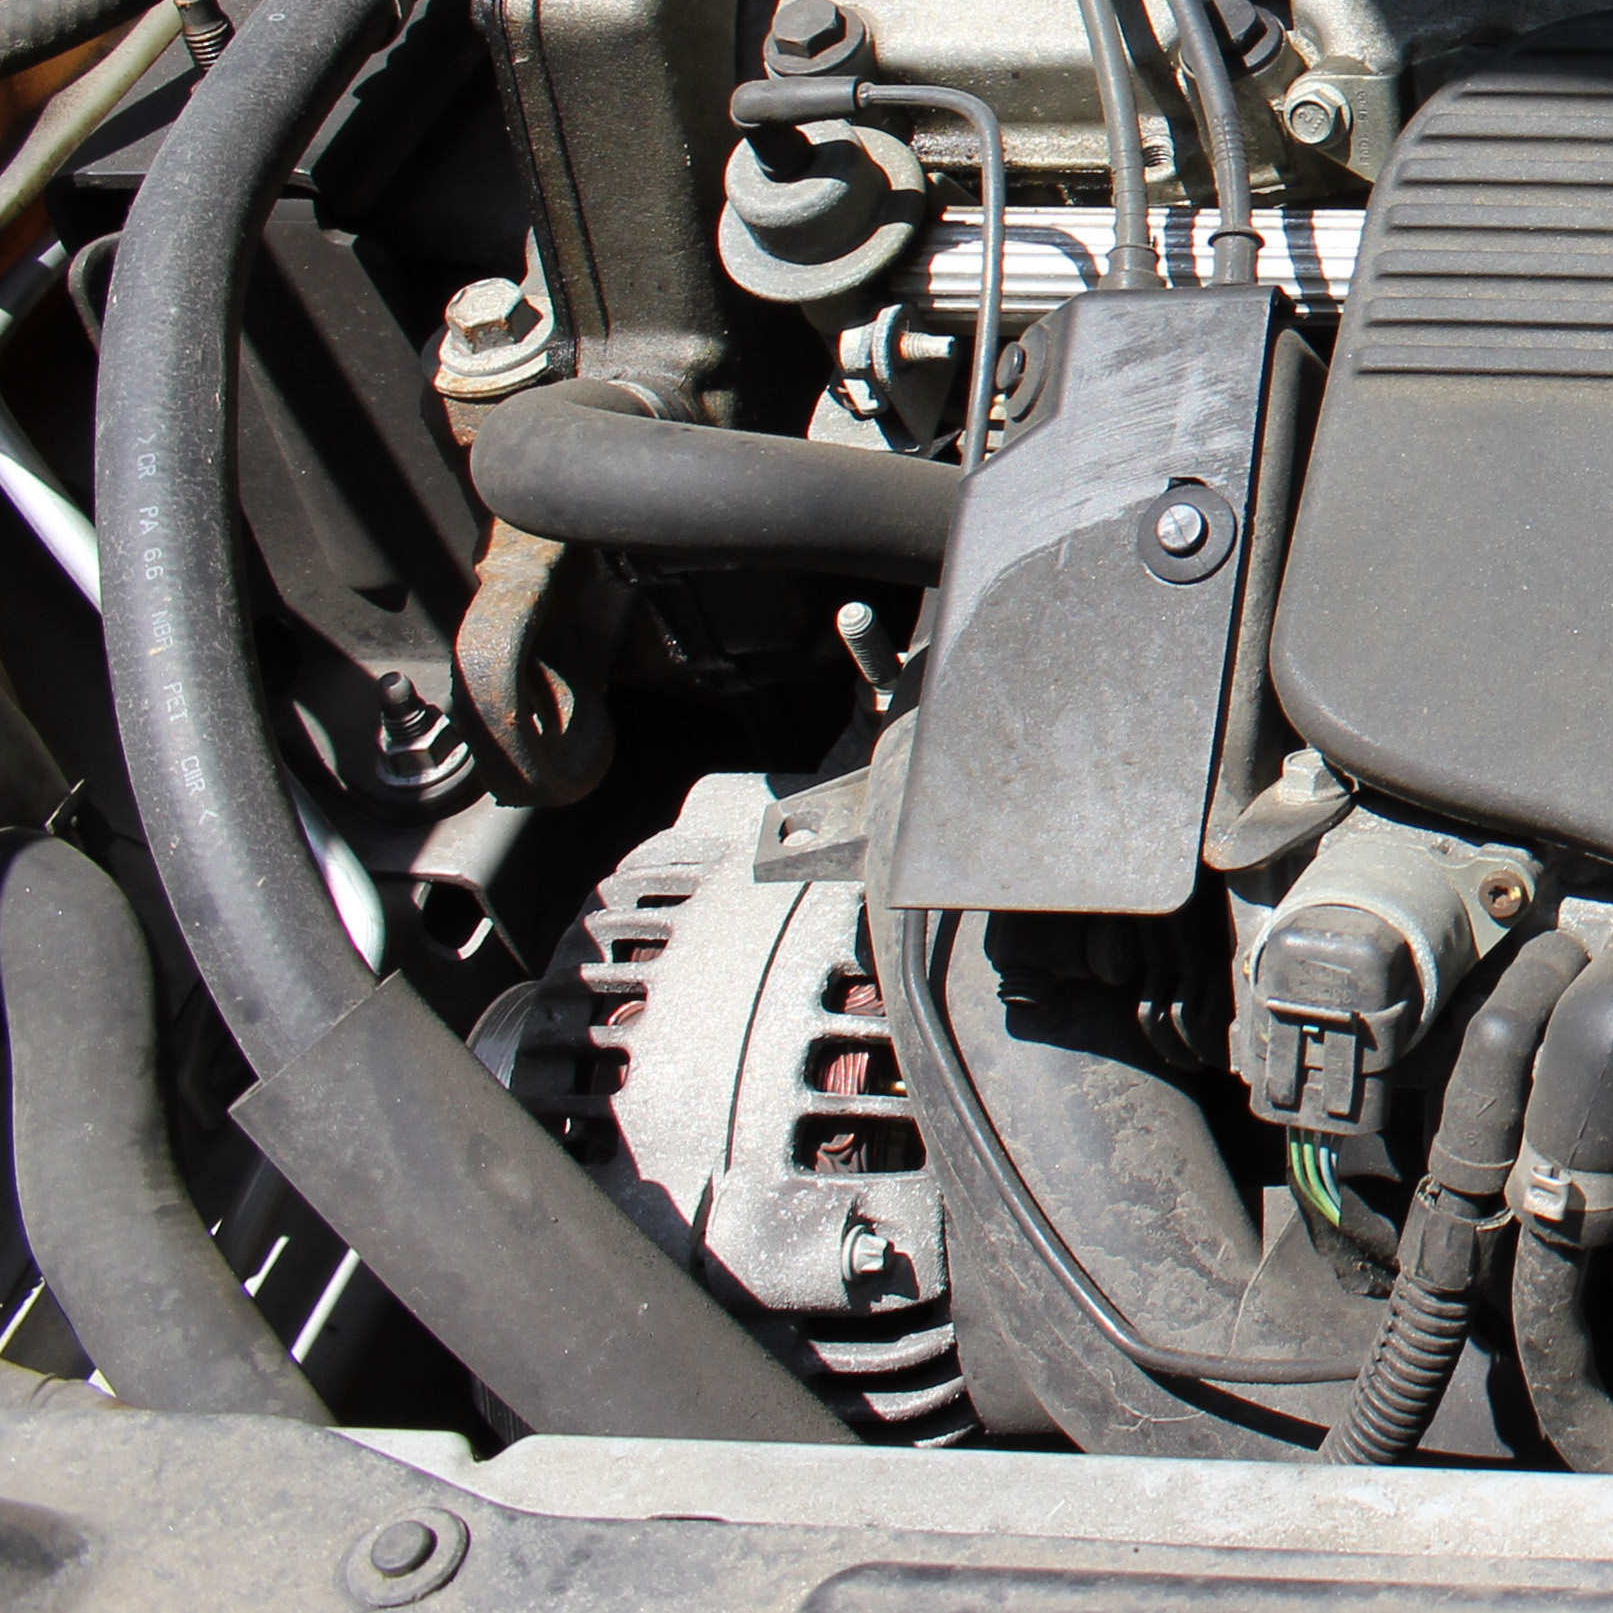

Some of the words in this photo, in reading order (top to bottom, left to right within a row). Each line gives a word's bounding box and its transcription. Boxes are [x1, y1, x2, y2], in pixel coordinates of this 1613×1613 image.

[138, 504, 160, 536] PA
[143, 546, 164, 581] 6.6
[162, 681, 189, 723] PET
[181, 755, 207, 797] CIIR
